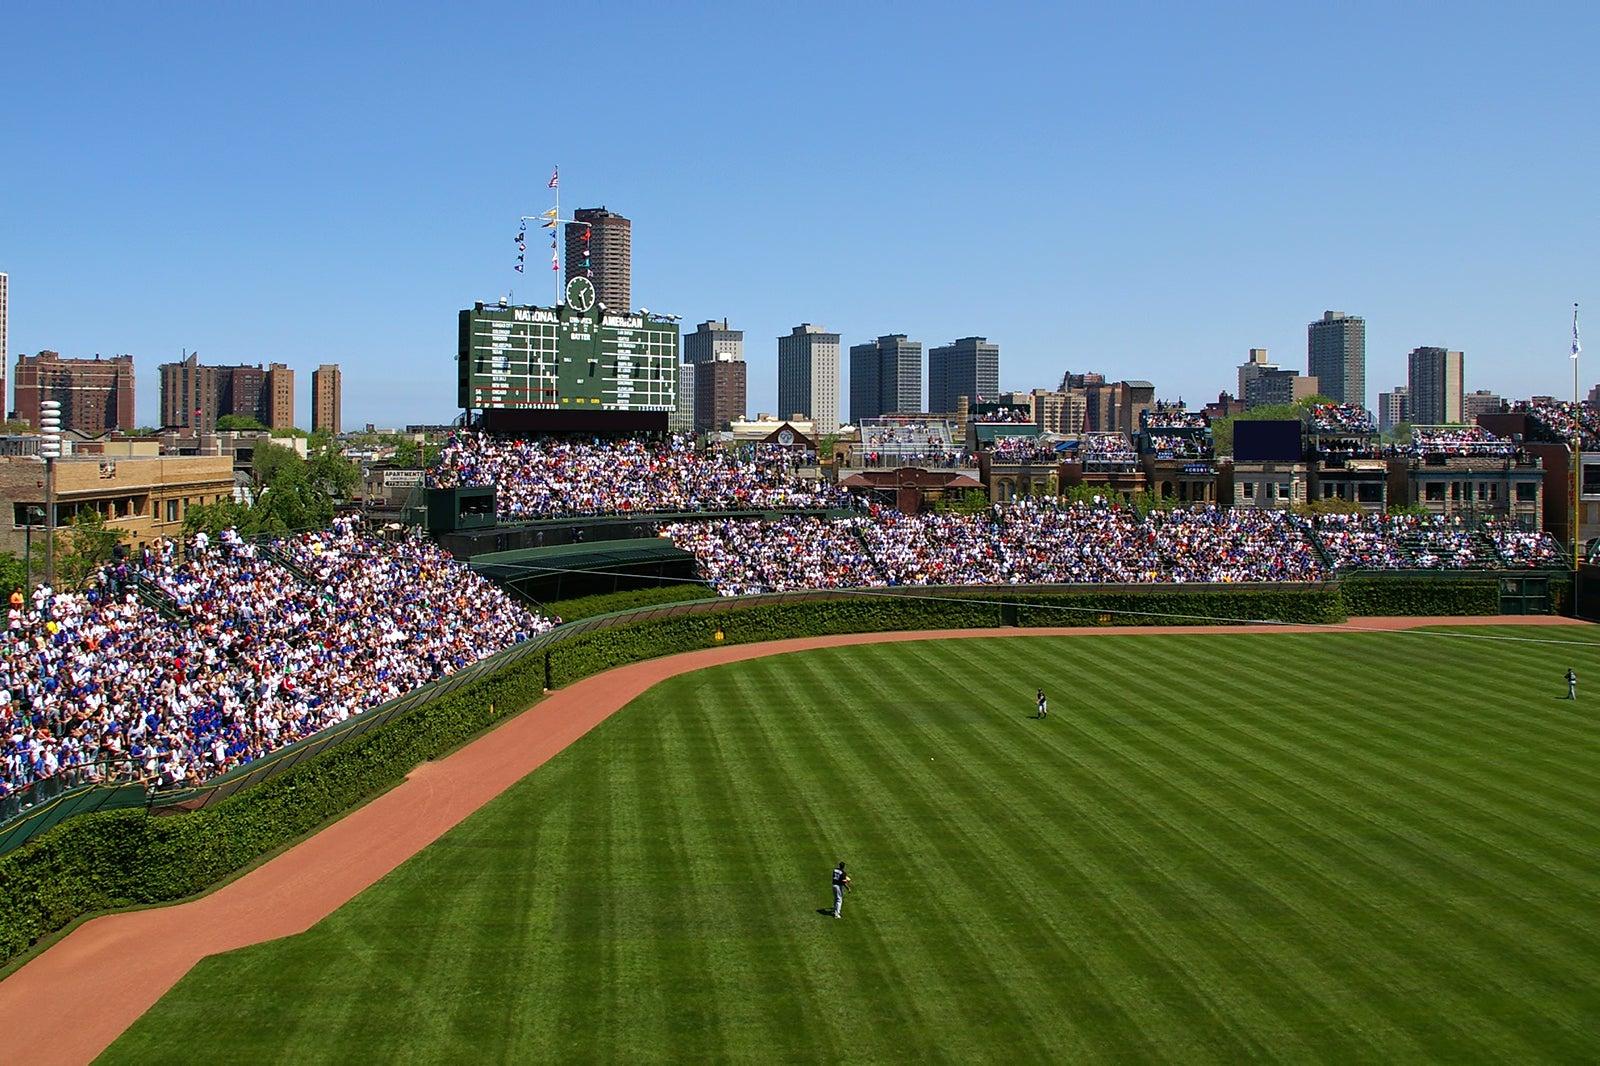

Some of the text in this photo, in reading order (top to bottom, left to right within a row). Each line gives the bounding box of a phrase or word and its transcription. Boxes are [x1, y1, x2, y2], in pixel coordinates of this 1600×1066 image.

[514, 309, 559, 323] NATIONAL
[602, 315, 643, 329] AMERICAN
[571, 332, 591, 341] BATTER
